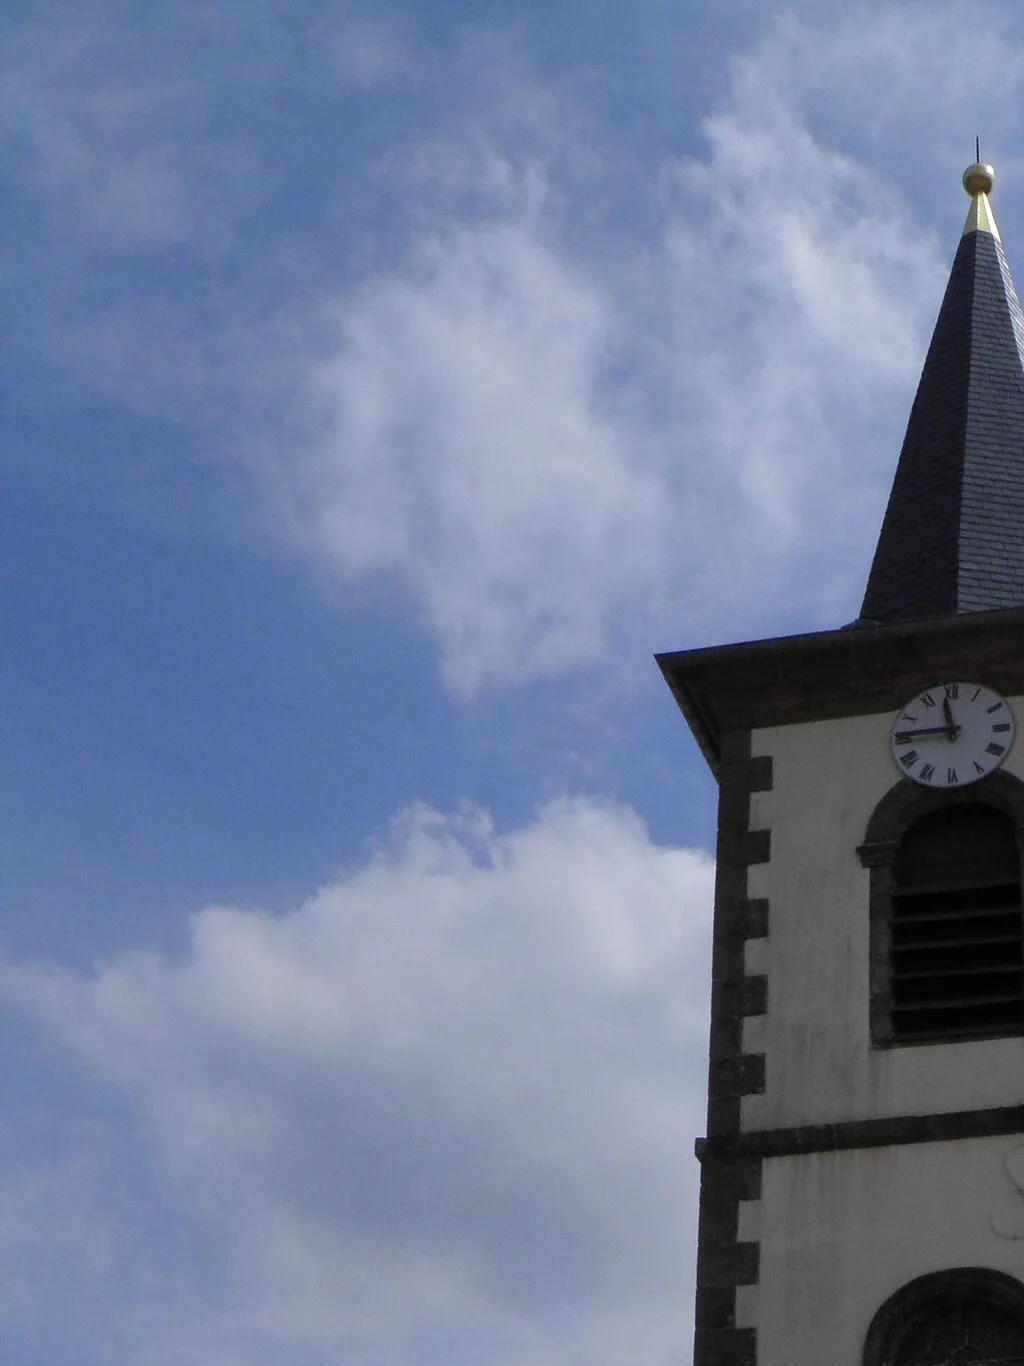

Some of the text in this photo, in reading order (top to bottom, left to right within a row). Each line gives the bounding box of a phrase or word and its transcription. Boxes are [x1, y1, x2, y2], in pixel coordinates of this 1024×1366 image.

[970, 688, 982, 702] I
[987, 702, 1004, 714] II
[992, 723, 1011, 733] III
